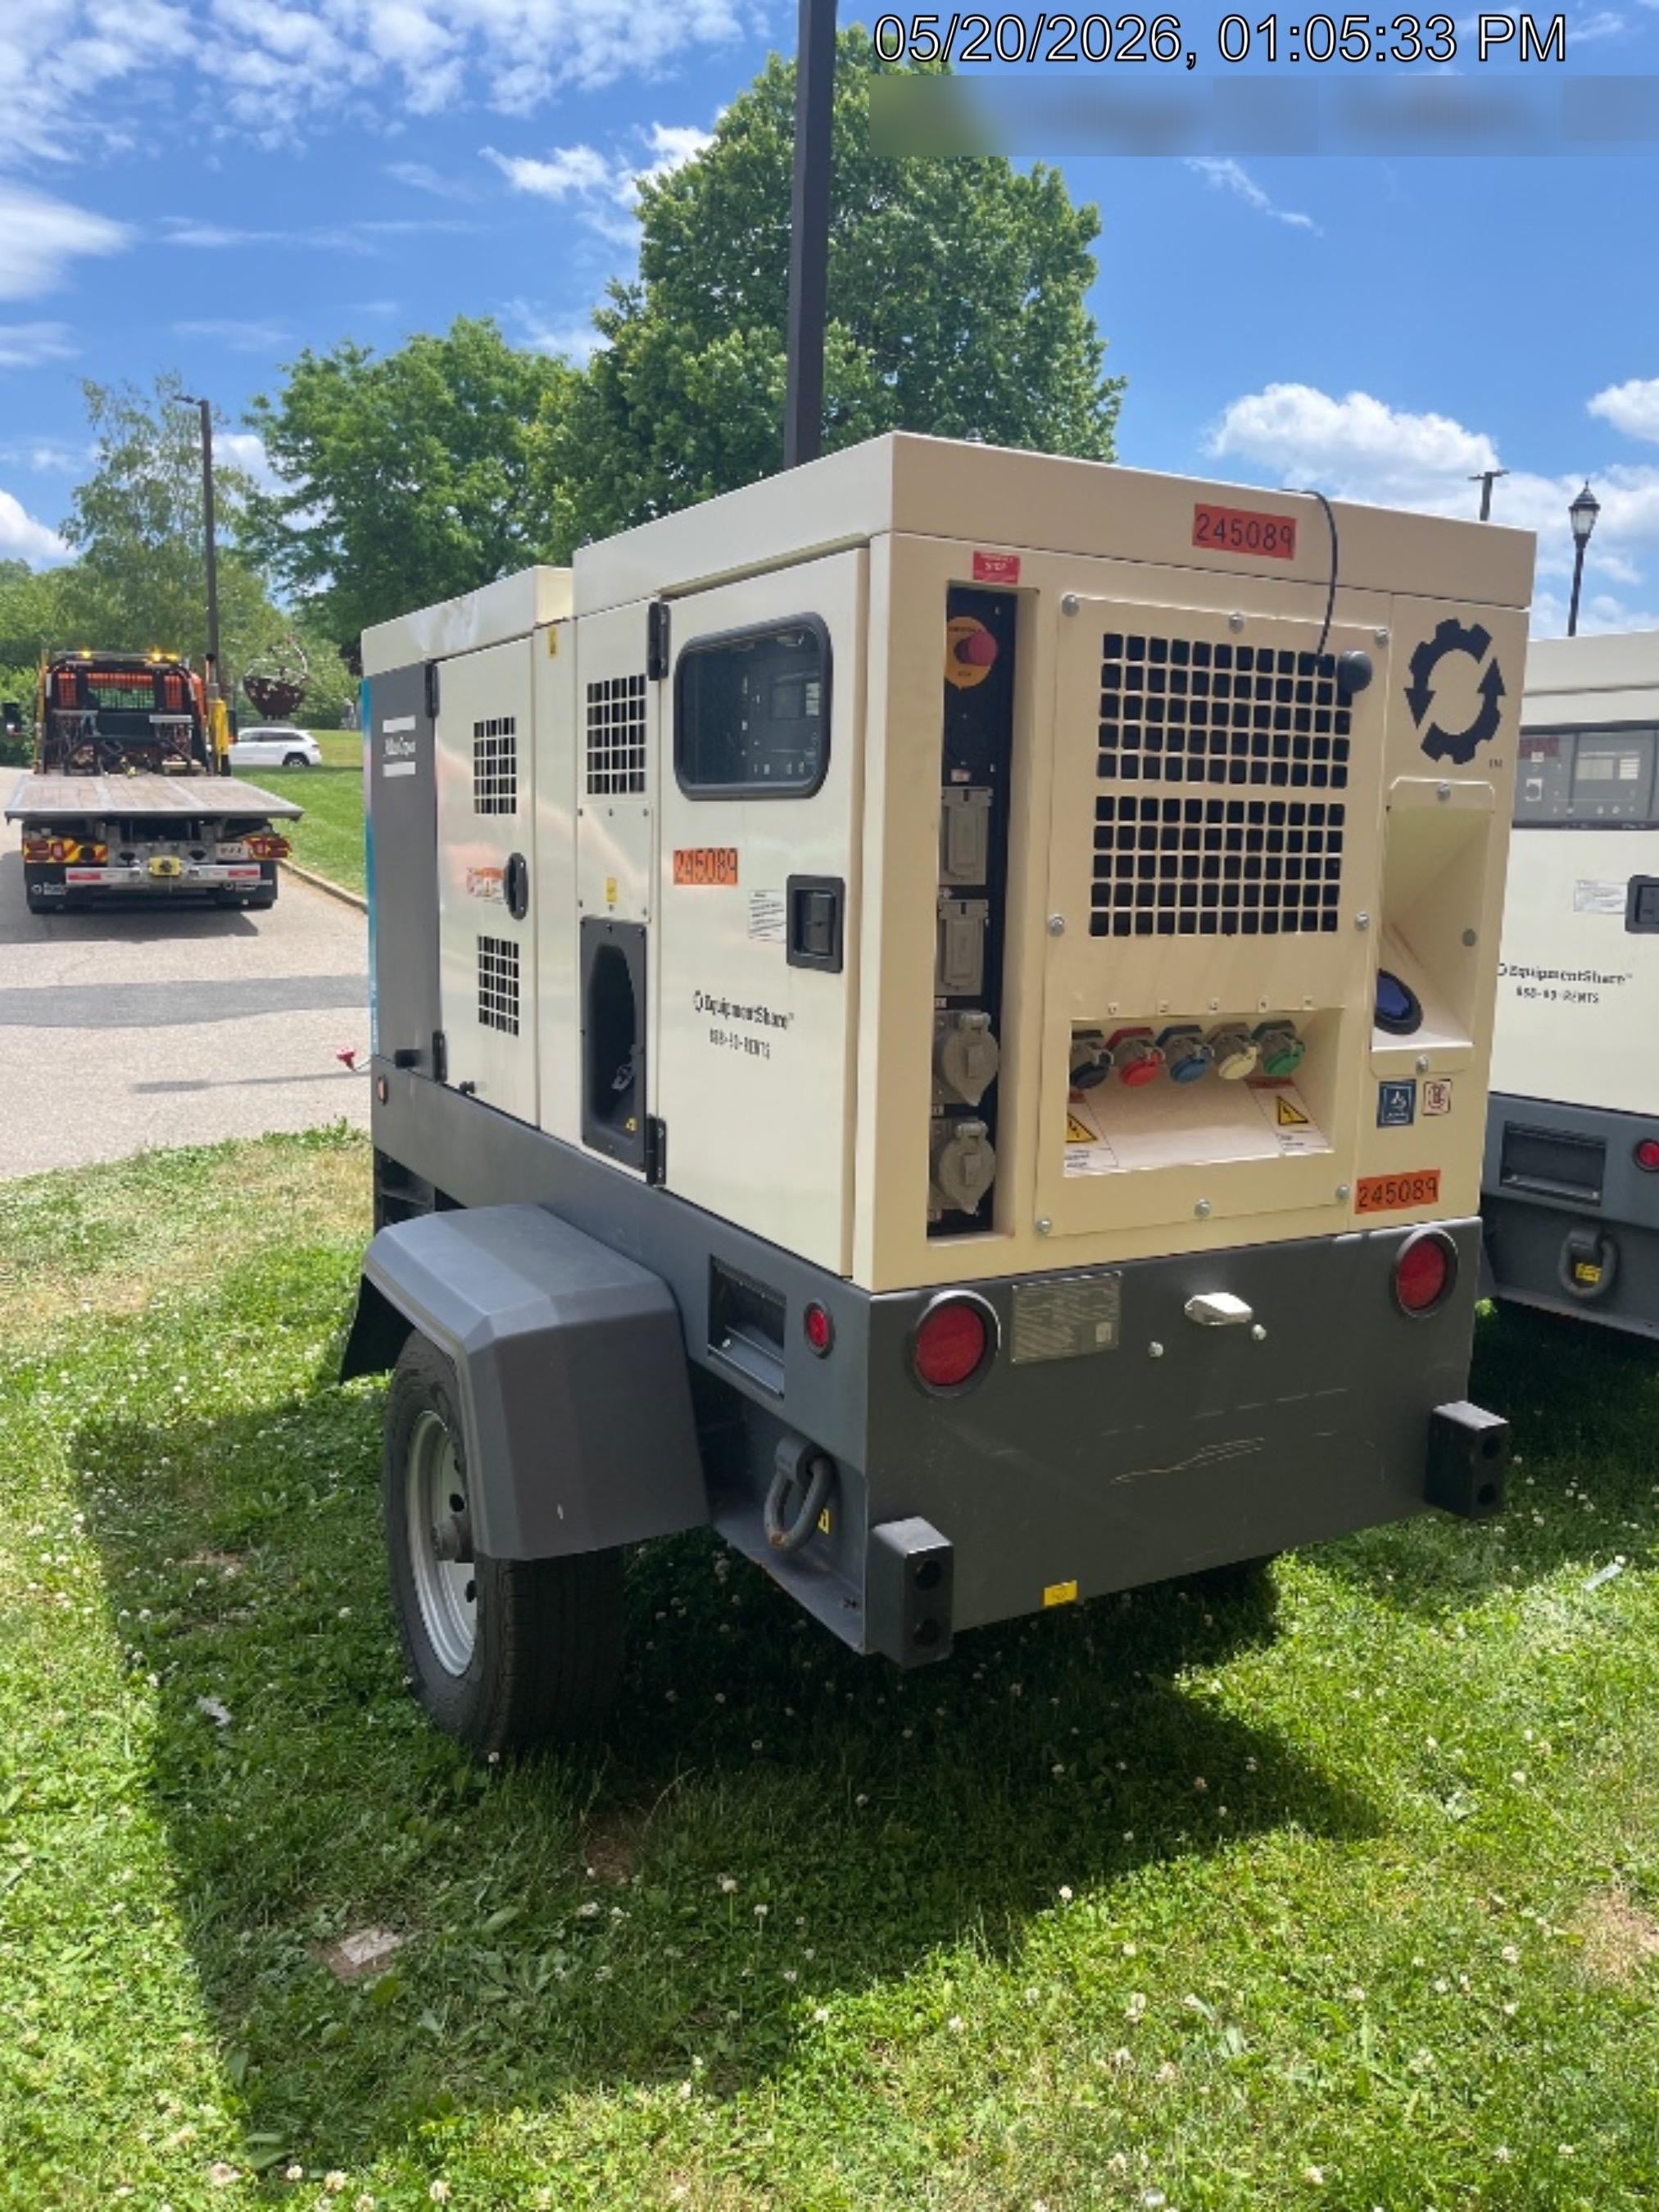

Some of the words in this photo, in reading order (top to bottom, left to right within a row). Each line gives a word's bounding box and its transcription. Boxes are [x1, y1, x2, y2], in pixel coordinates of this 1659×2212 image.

[1196, 513, 1292, 554] 245089
[674, 847, 737, 884] 245089
[1358, 1176, 1437, 1208] 245089
